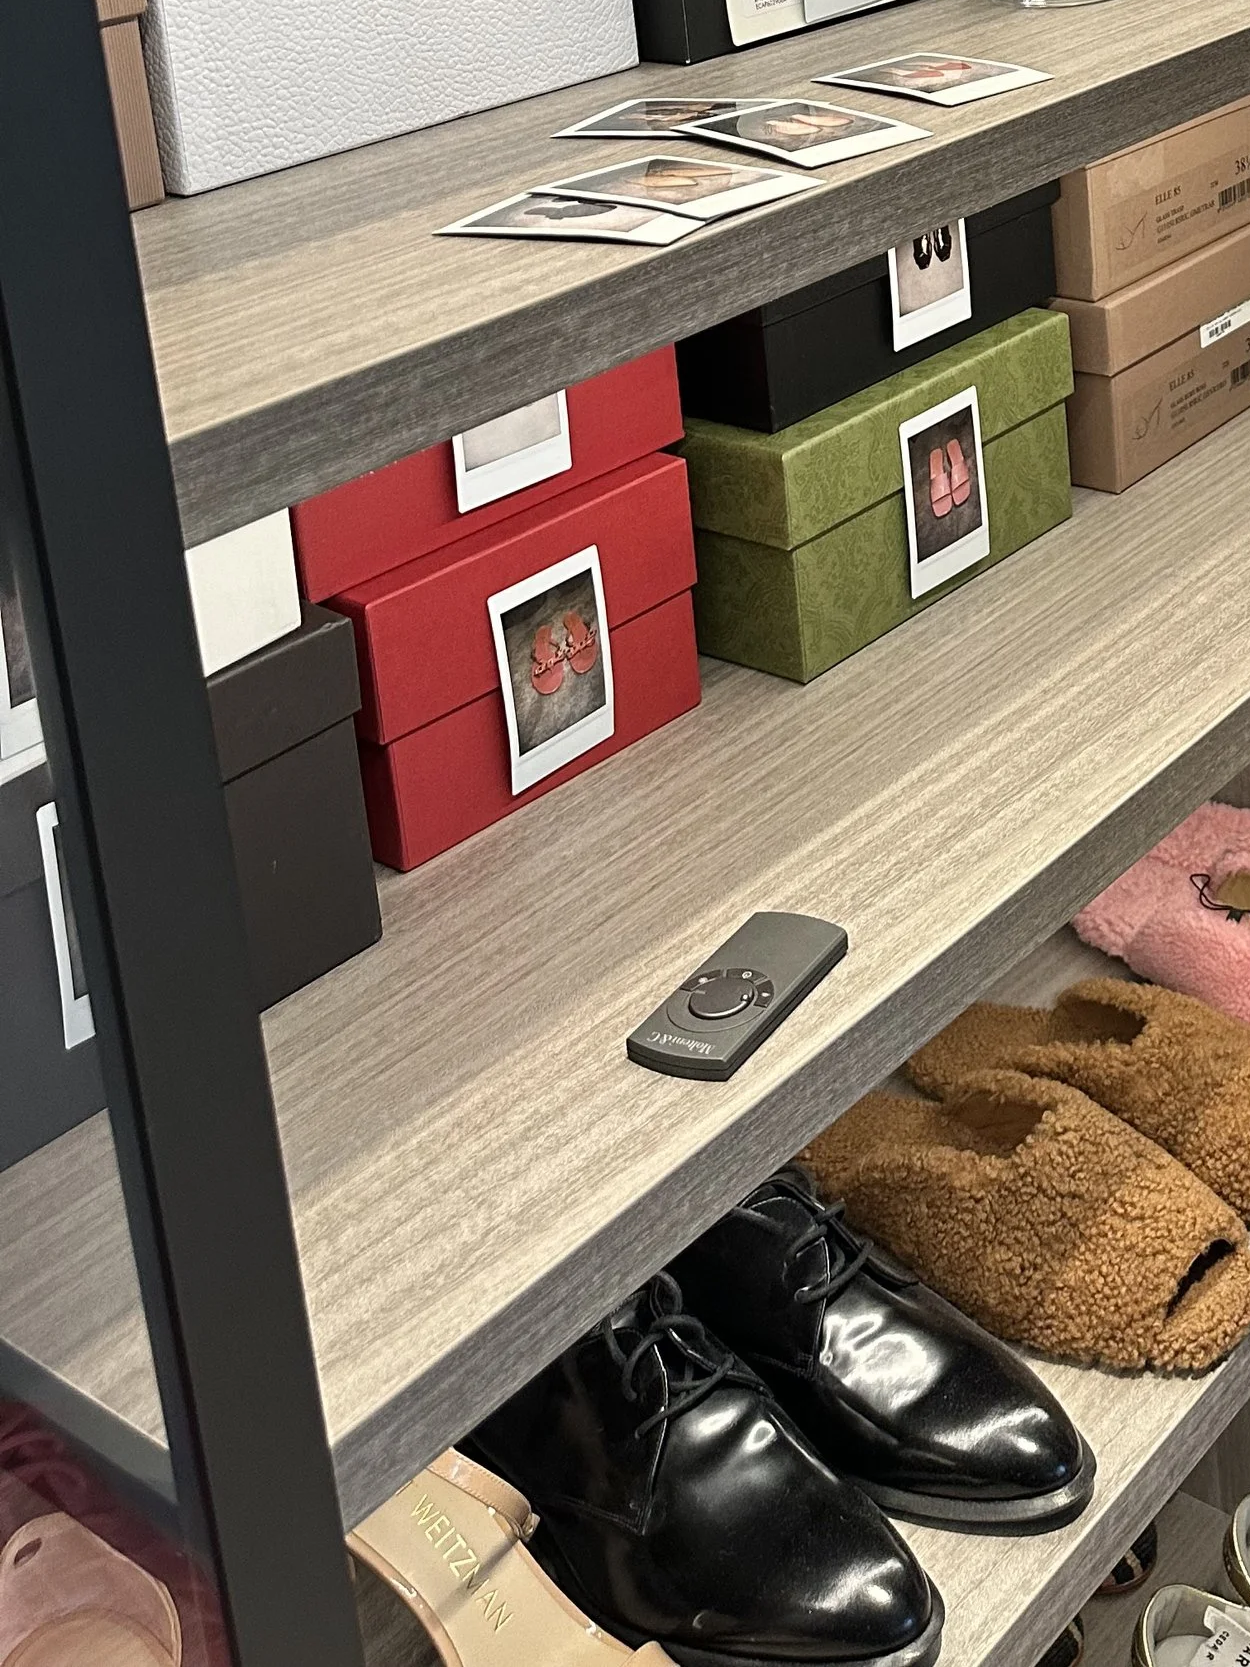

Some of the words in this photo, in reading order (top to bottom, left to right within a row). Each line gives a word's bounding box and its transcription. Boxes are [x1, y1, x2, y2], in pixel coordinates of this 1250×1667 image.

[1155, 189, 1172, 206] ELLE
[1169, 374, 1186, 392] ELLE
[410, 1493, 515, 1635] WEITZMAN
